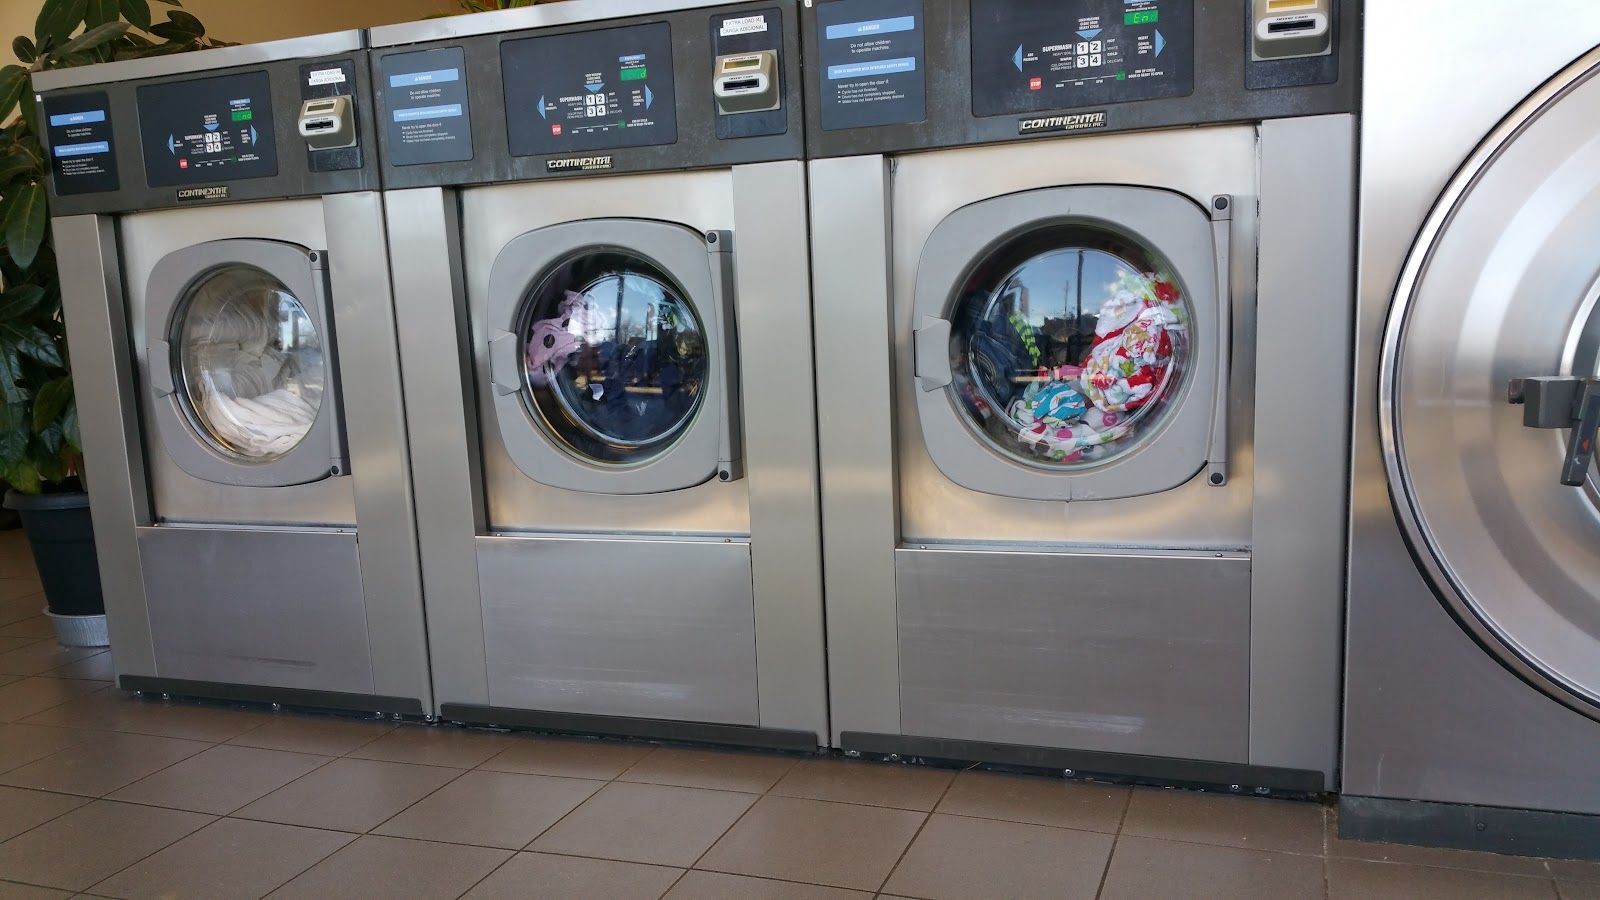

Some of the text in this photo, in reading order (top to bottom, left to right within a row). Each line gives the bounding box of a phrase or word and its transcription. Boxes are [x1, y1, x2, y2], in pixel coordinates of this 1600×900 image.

[1042, 44, 1072, 52] SUPERWASH
[1080, 58, 1086, 66] 3
[1022, 112, 1105, 129] CONTINENTAL
[548, 156, 611, 168] CONTINENTAL
[178, 186, 228, 198] CONTINENTAL
